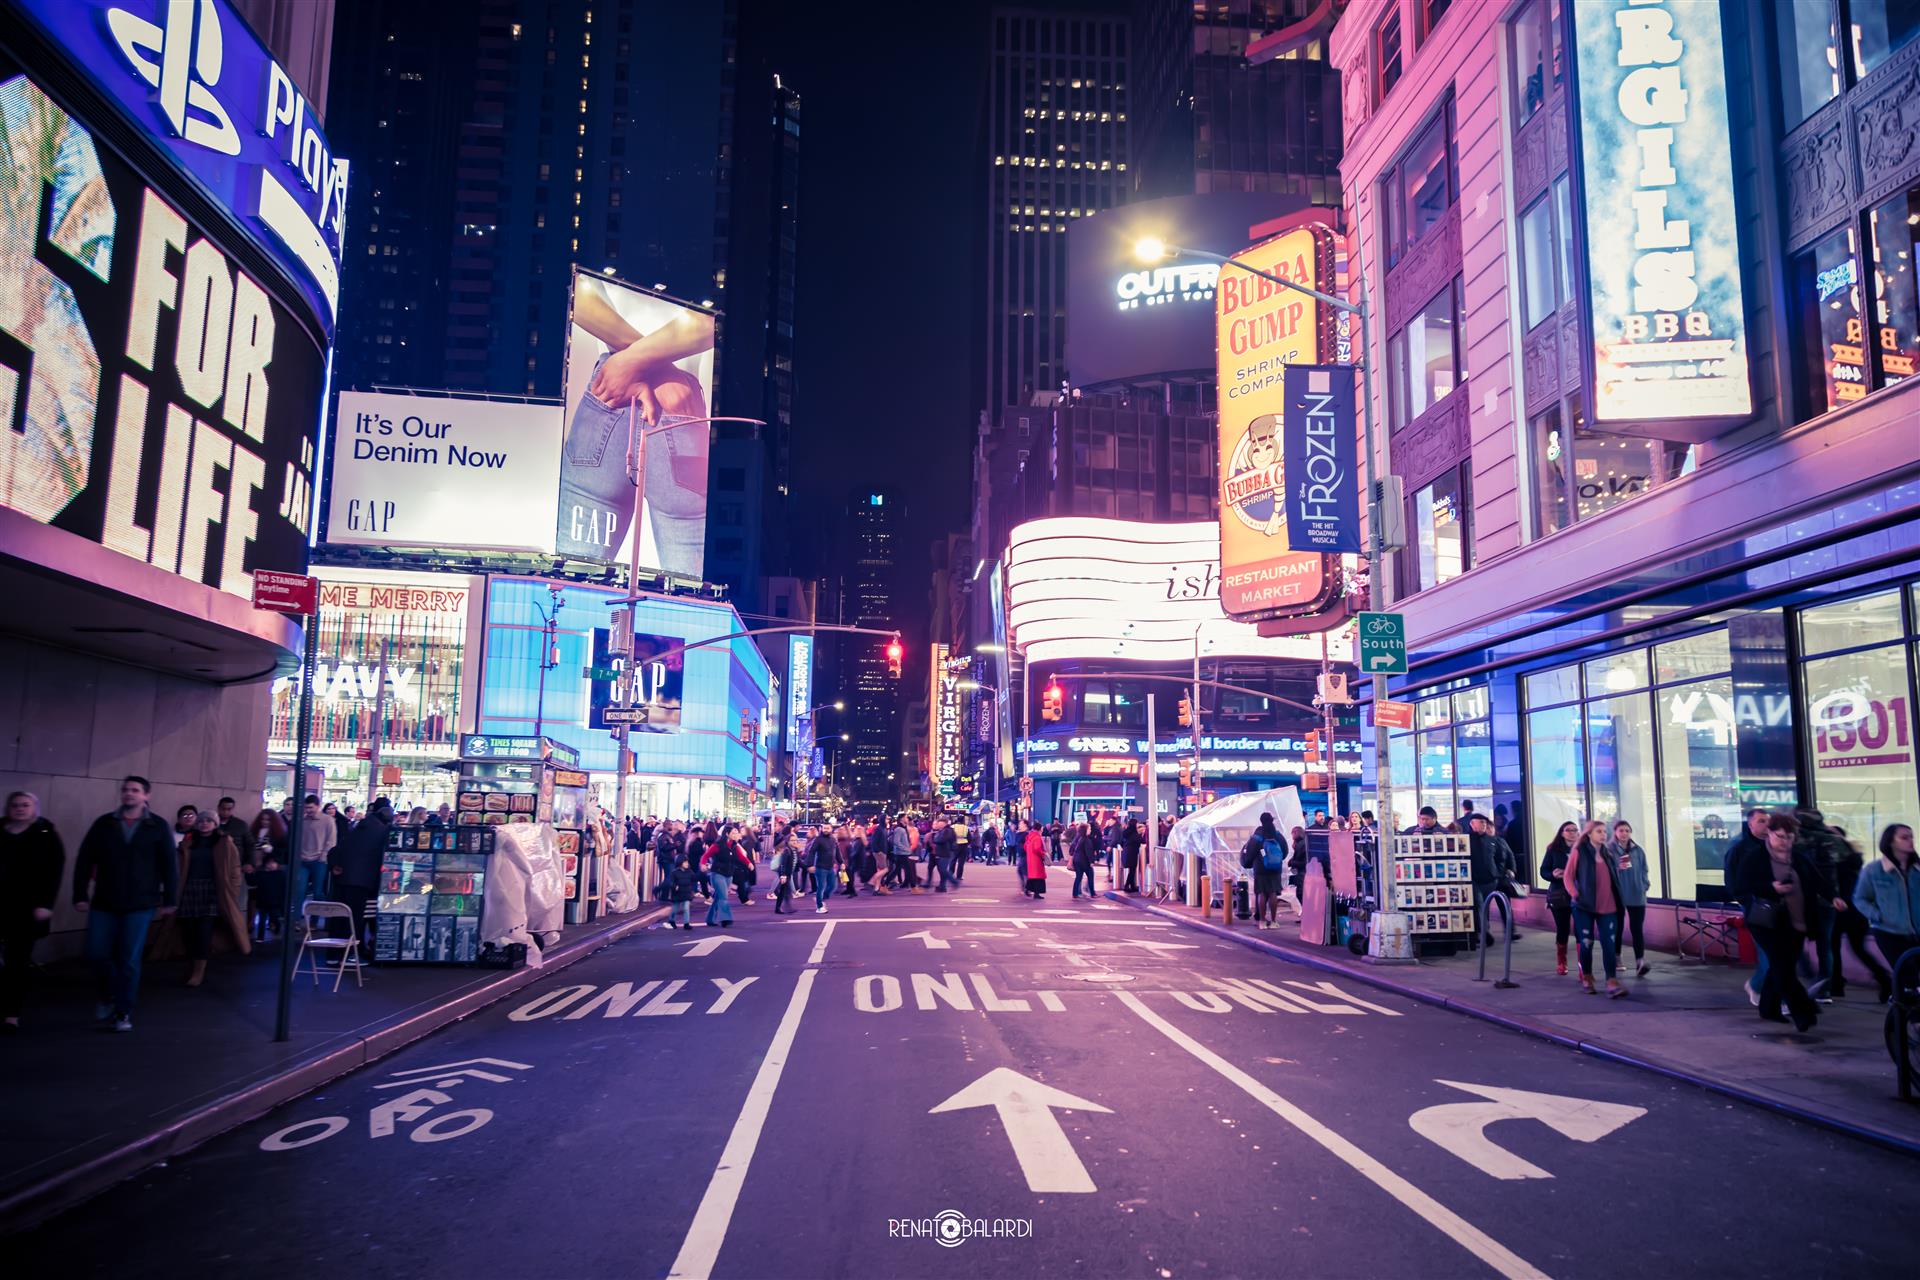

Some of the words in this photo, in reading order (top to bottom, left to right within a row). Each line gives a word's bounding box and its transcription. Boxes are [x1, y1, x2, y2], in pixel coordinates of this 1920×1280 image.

[1222, 253, 1310, 316] BUBBA
[126, 186, 276, 444] FOR
[1229, 302, 1304, 356] GUMP
[1623, 312, 1712, 339] BBQ
[1236, 350, 1299, 381] SHRIMP
[355, 412, 393, 436] It’s
[402, 416, 452, 440] Our
[354, 439, 438, 464] Denim
[447, 445, 507, 469] Now
[1301, 394, 1344, 522] FROZEN
[102, 373, 266, 600] LIFE
[1227, 470, 1271, 502] BUBBA
[1241, 491, 1274, 508] SHRIMP
[347, 499, 396, 533] GAP
[570, 505, 617, 547] GAP
[258, 574, 270, 583] NO
[271, 575, 308, 587] STANDING
[1225, 559, 1318, 588] RESTAURANT
[258, 583, 290, 594] Anytime
[370, 588, 464, 611] MERRY
[1241, 582, 1301, 604] MARKET
[1362, 639, 1404, 649] South
[611, 658, 666, 704] GAP
[941, 678, 958, 775] VIRGILS
[491, 738, 510, 746] TIMES
[511, 739, 537, 748] SQUARE
[510, 748, 529, 756] FOOD
[1026, 739, 1059, 751] Police
[1082, 738, 1130, 752] NEWS
[1213, 737, 1261, 750] border
[1263, 738, 1292, 750] wall
[1090, 758, 1139, 774] ESPN
[1820, 757, 1868, 767] BROADWAY
[507, 976, 760, 1021] ONLY
